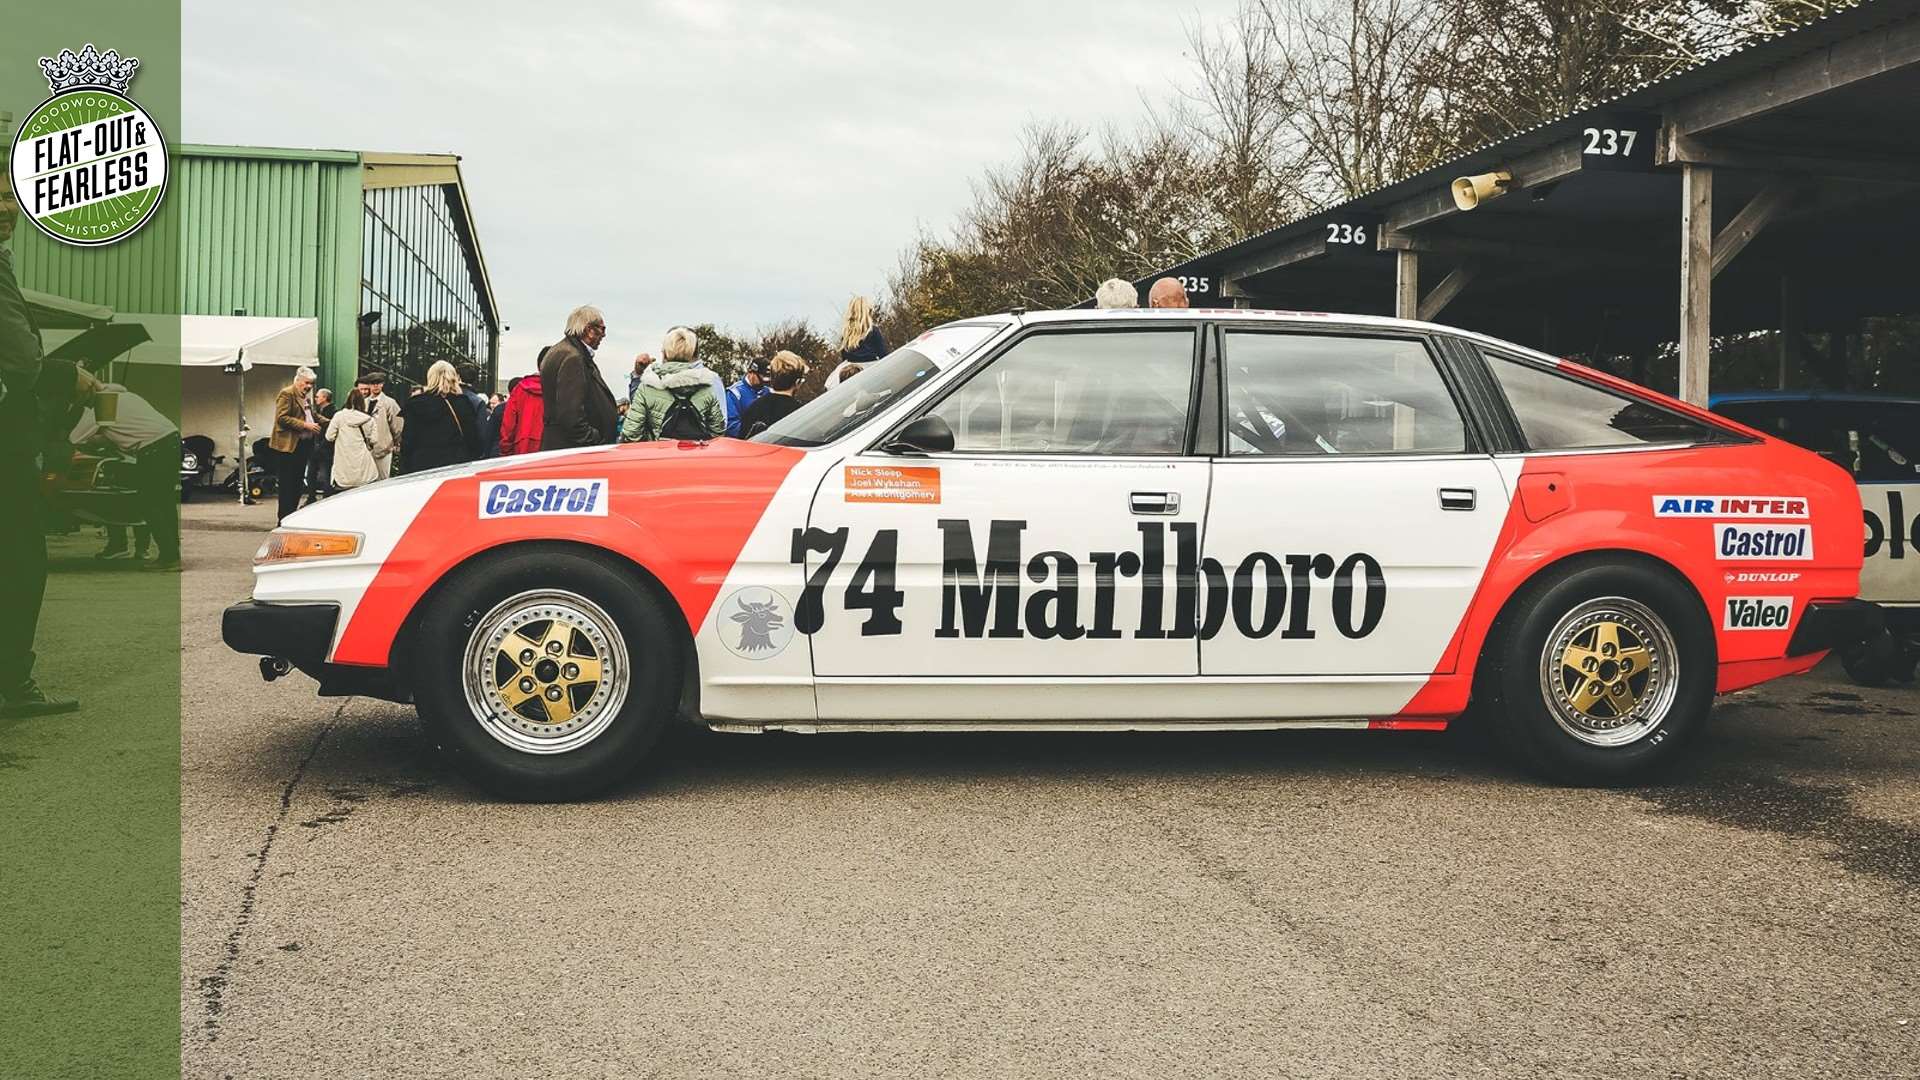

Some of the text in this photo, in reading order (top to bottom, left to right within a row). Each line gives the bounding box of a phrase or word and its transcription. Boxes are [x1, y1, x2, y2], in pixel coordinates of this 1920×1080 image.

[1583, 127, 1637, 157] 237
[1326, 223, 1367, 245] 236
[850, 468, 873, 476] Nick
[850, 478, 872, 487] Joel
[486, 482, 601, 515] Castrol
[1659, 499, 1806, 515] AIR INTER
[1720, 526, 1806, 557] Castrol
[790, 518, 1387, 641] 74 Marlboro
[1737, 572, 1800, 583] DUNLOP
[1728, 599, 1789, 628] Valeo
